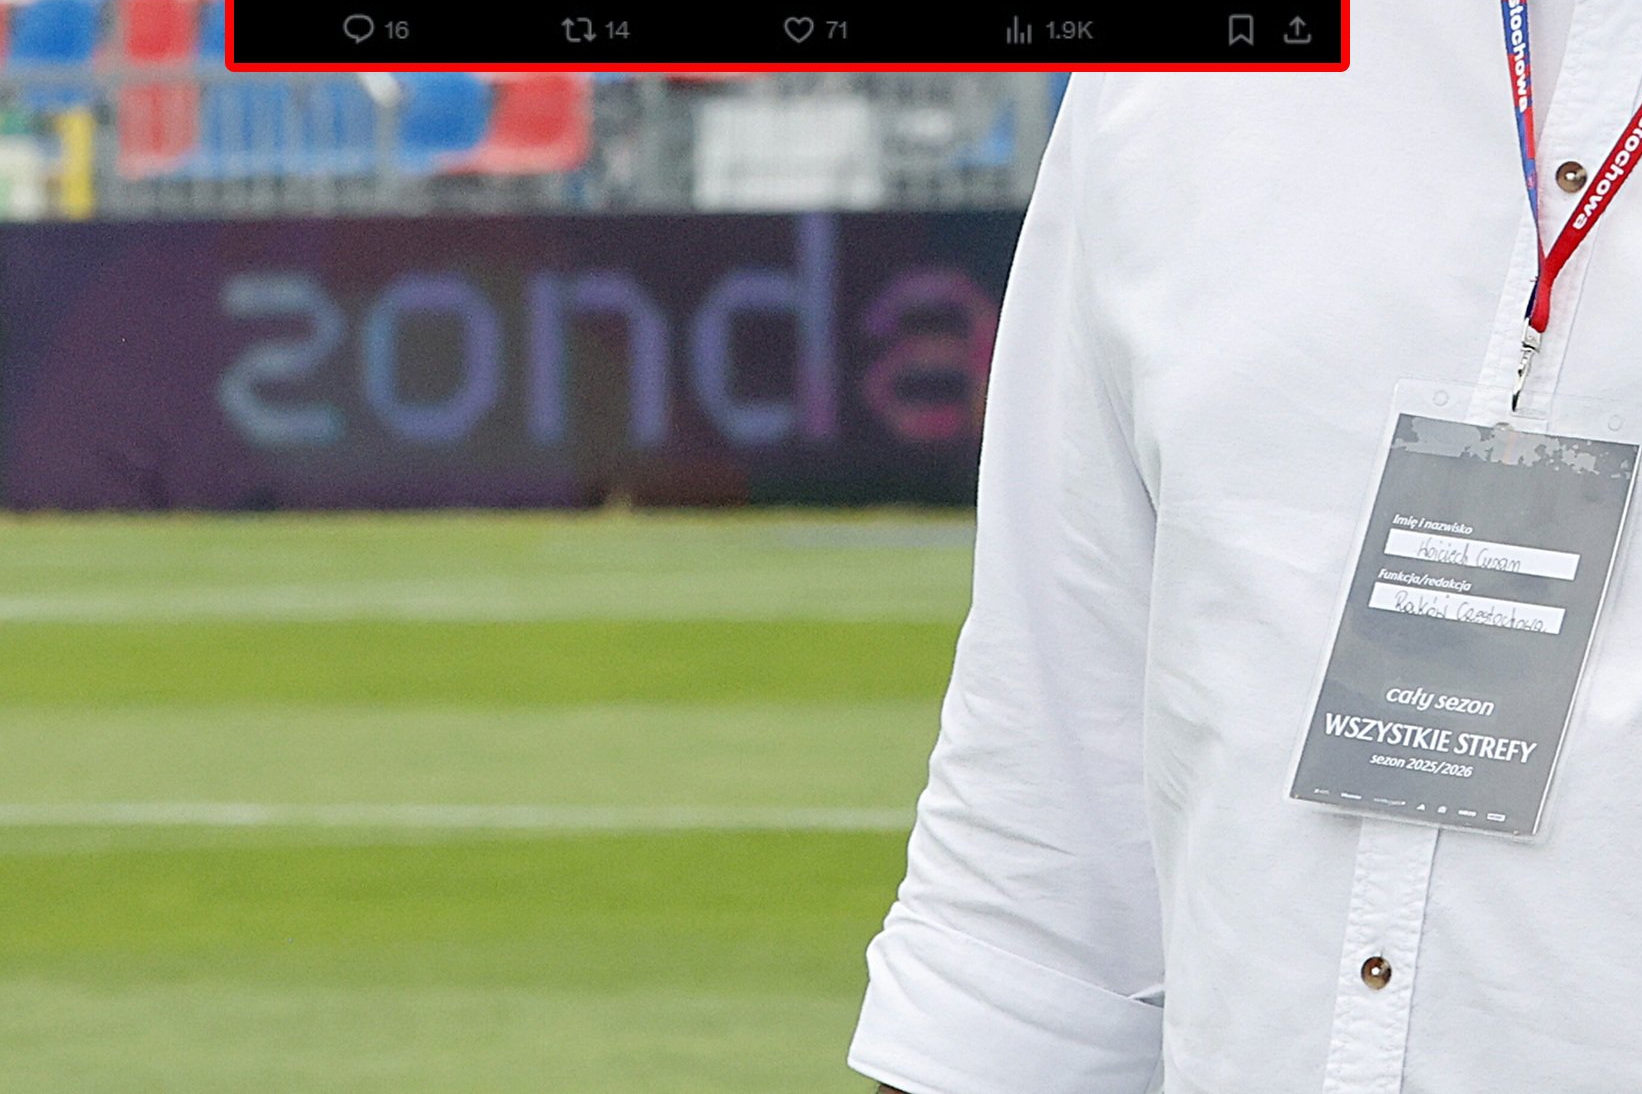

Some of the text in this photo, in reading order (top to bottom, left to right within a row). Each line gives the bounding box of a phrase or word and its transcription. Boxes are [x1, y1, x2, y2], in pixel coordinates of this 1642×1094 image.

[1392, 513, 1418, 528] Imię
[1424, 520, 1474, 536] nazwisko
[1377, 568, 1472, 592] Funkcja/redakcja
[1386, 687, 1495, 716] cały sezon
[1324, 712, 1538, 763] WSZYSTKIE STREFY
[1369, 753, 1474, 778] sezon 2025/2026
